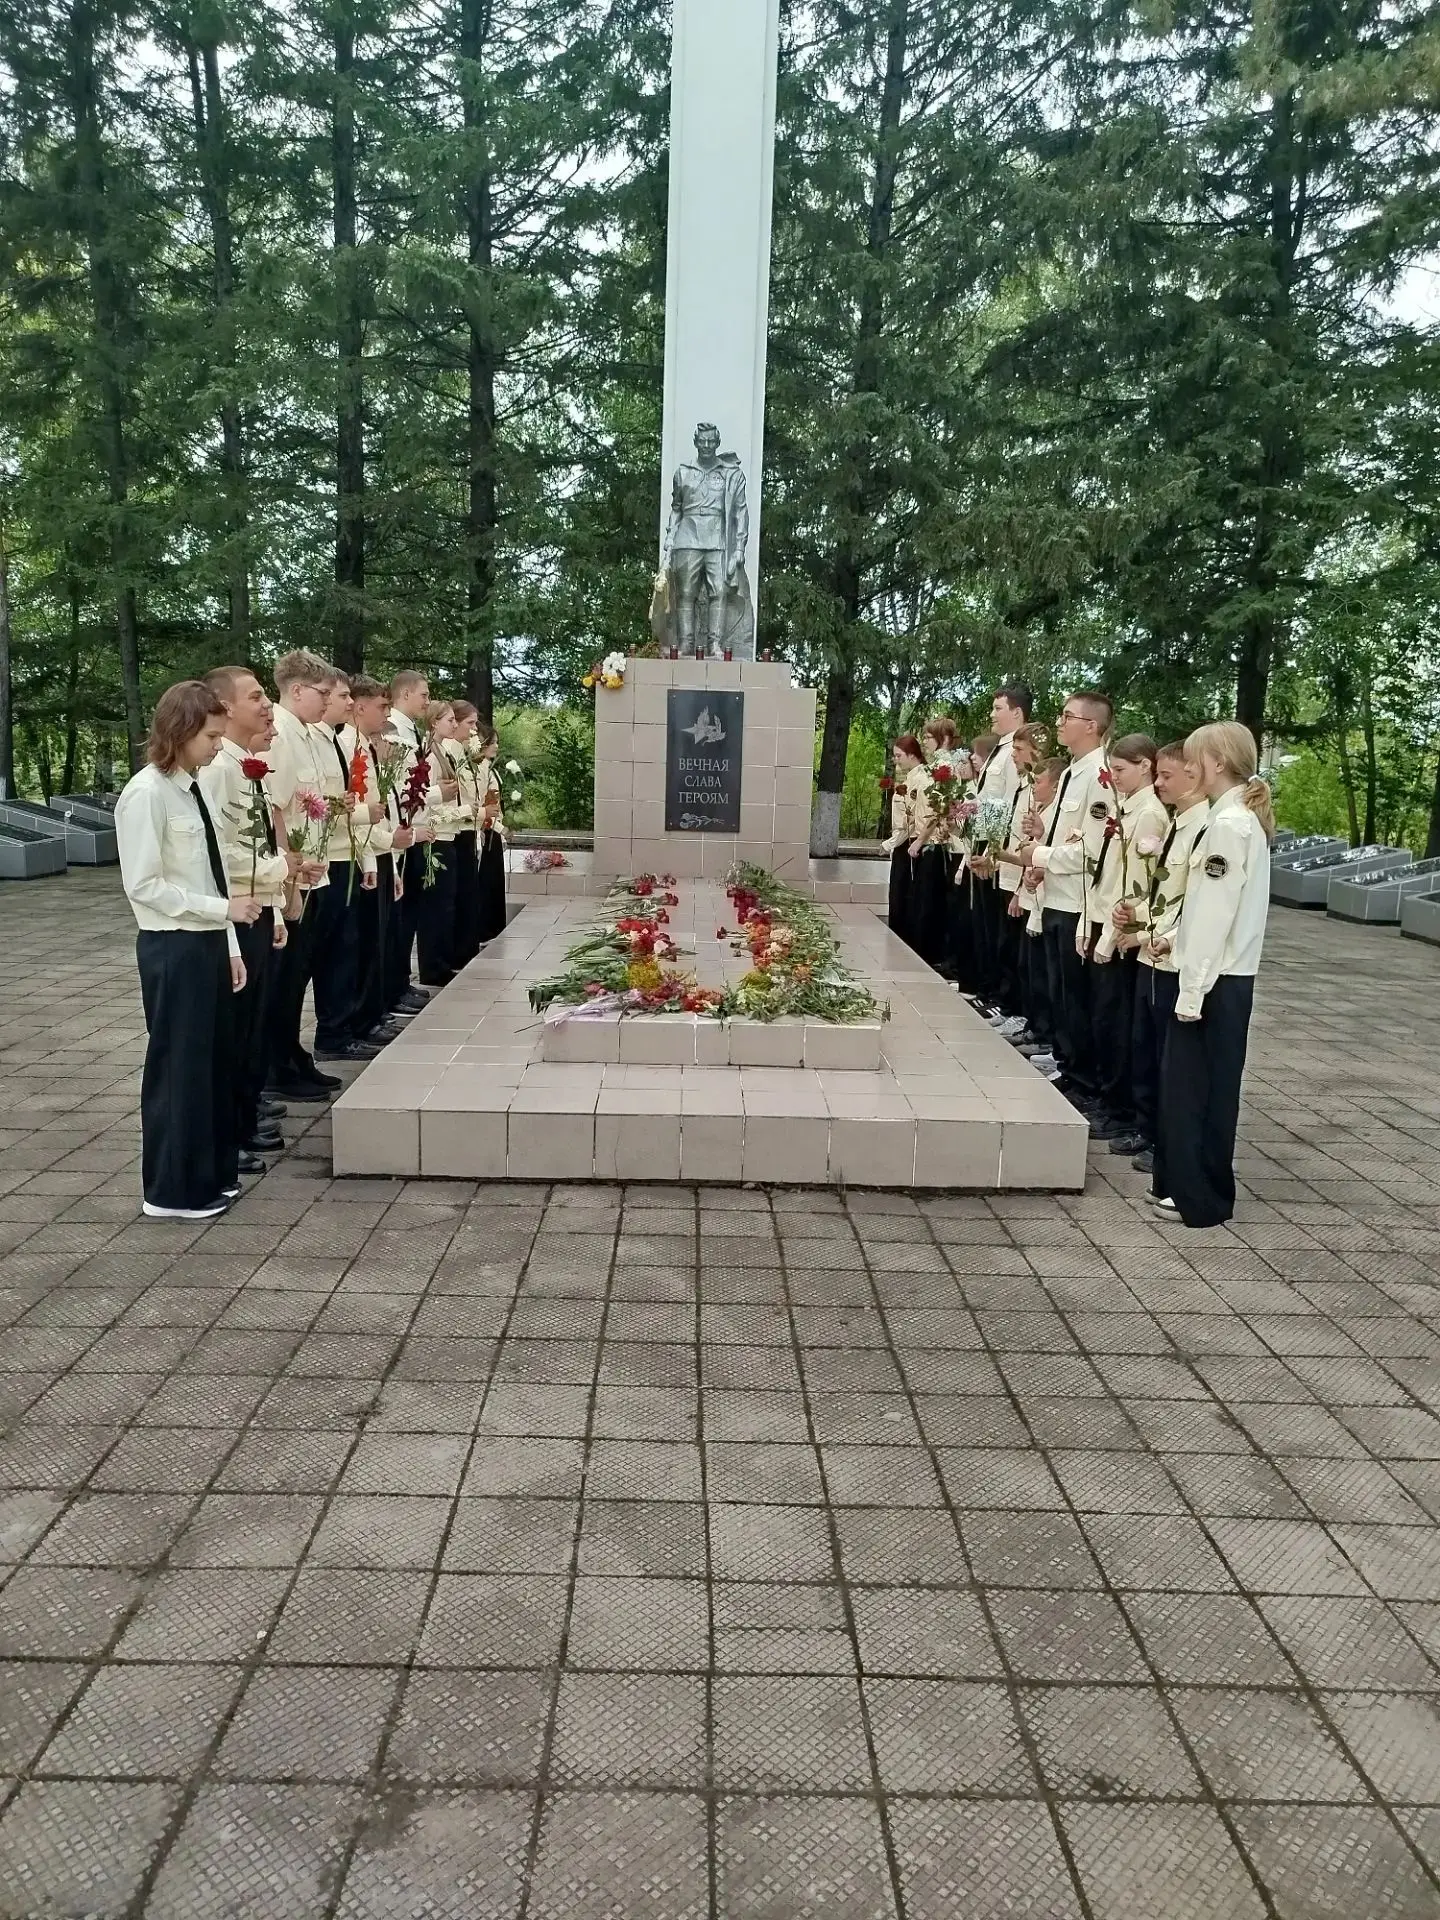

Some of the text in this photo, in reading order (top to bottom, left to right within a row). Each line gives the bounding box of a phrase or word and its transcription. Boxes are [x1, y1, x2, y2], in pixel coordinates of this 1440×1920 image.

[679, 758, 729, 771] ВЕЧНАЯ
[684, 775, 722, 787] СЛАВА
[678, 792, 729, 804] ГЕРОЯМ
